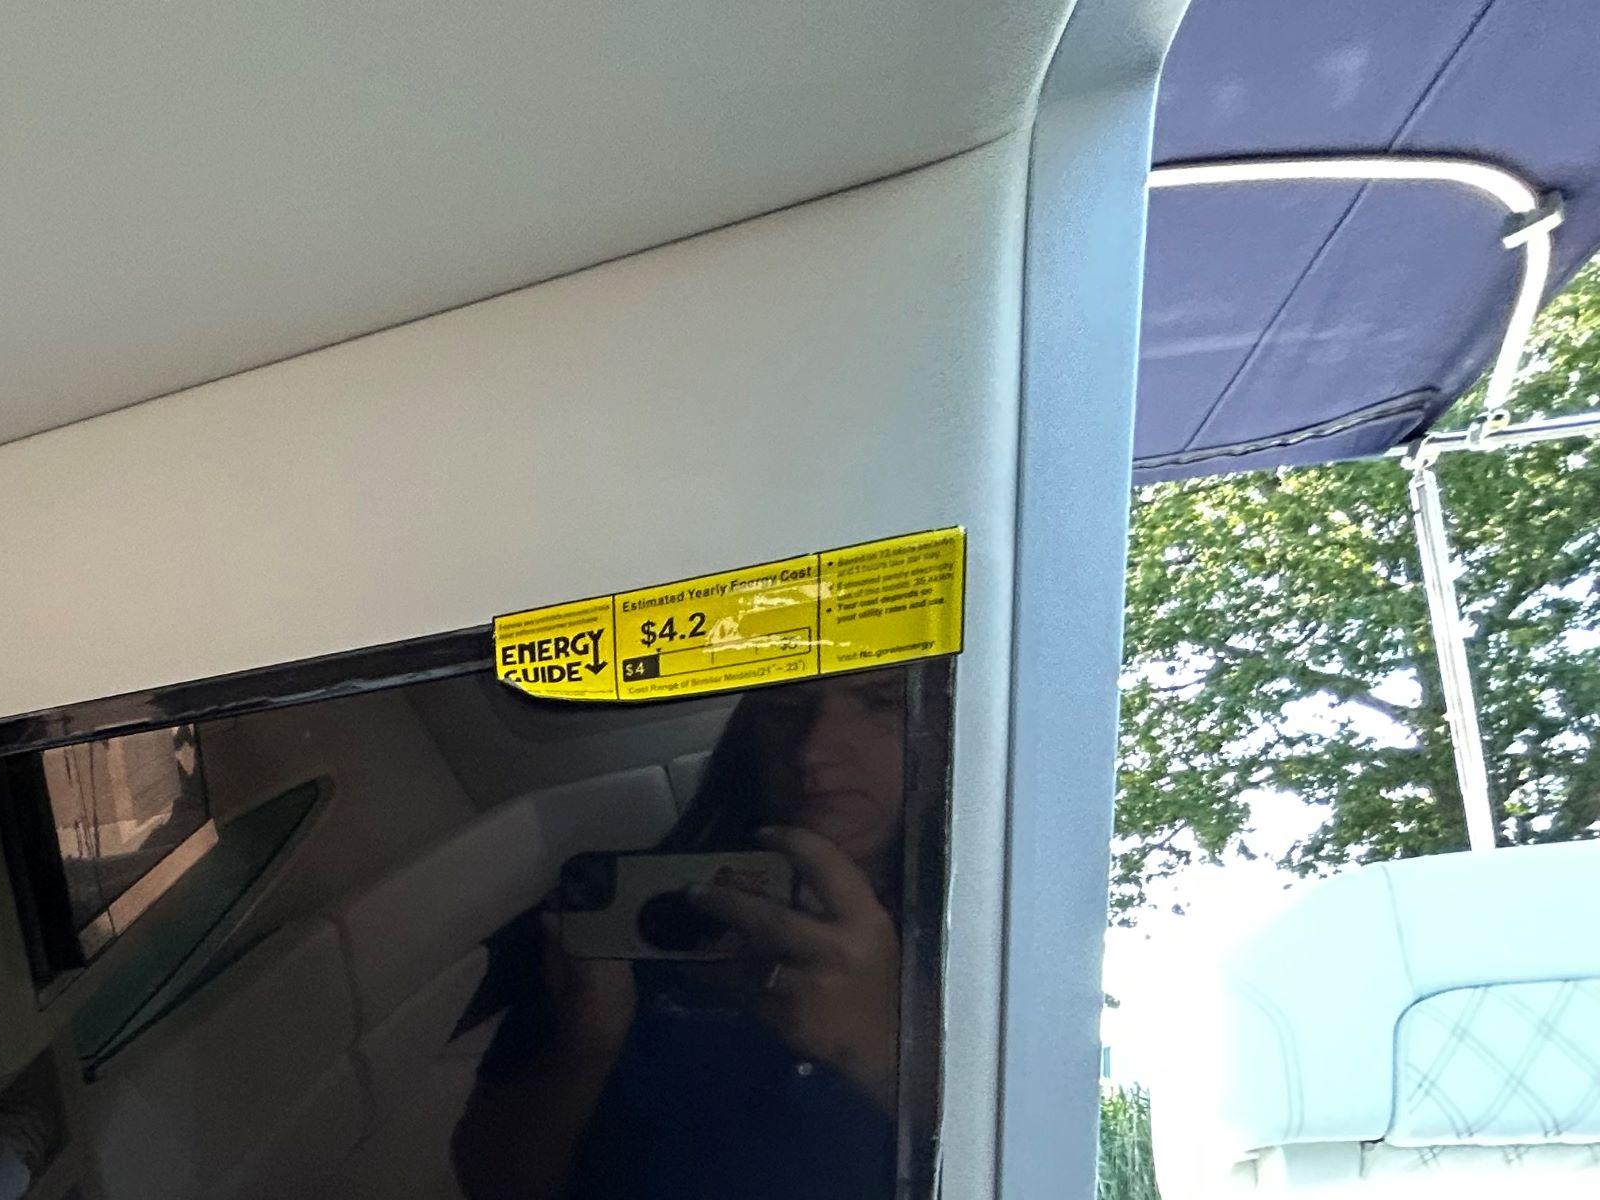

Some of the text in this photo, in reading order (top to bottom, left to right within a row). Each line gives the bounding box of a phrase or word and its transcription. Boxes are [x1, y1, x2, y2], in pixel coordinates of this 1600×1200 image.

[622, 591, 685, 613] Estimated
[688, 583, 728, 600] Yearly
[780, 566, 812, 583] Cost
[502, 628, 606, 668] ENERGY
[504, 661, 583, 684] GUIDE
[625, 661, 645, 677] $4
